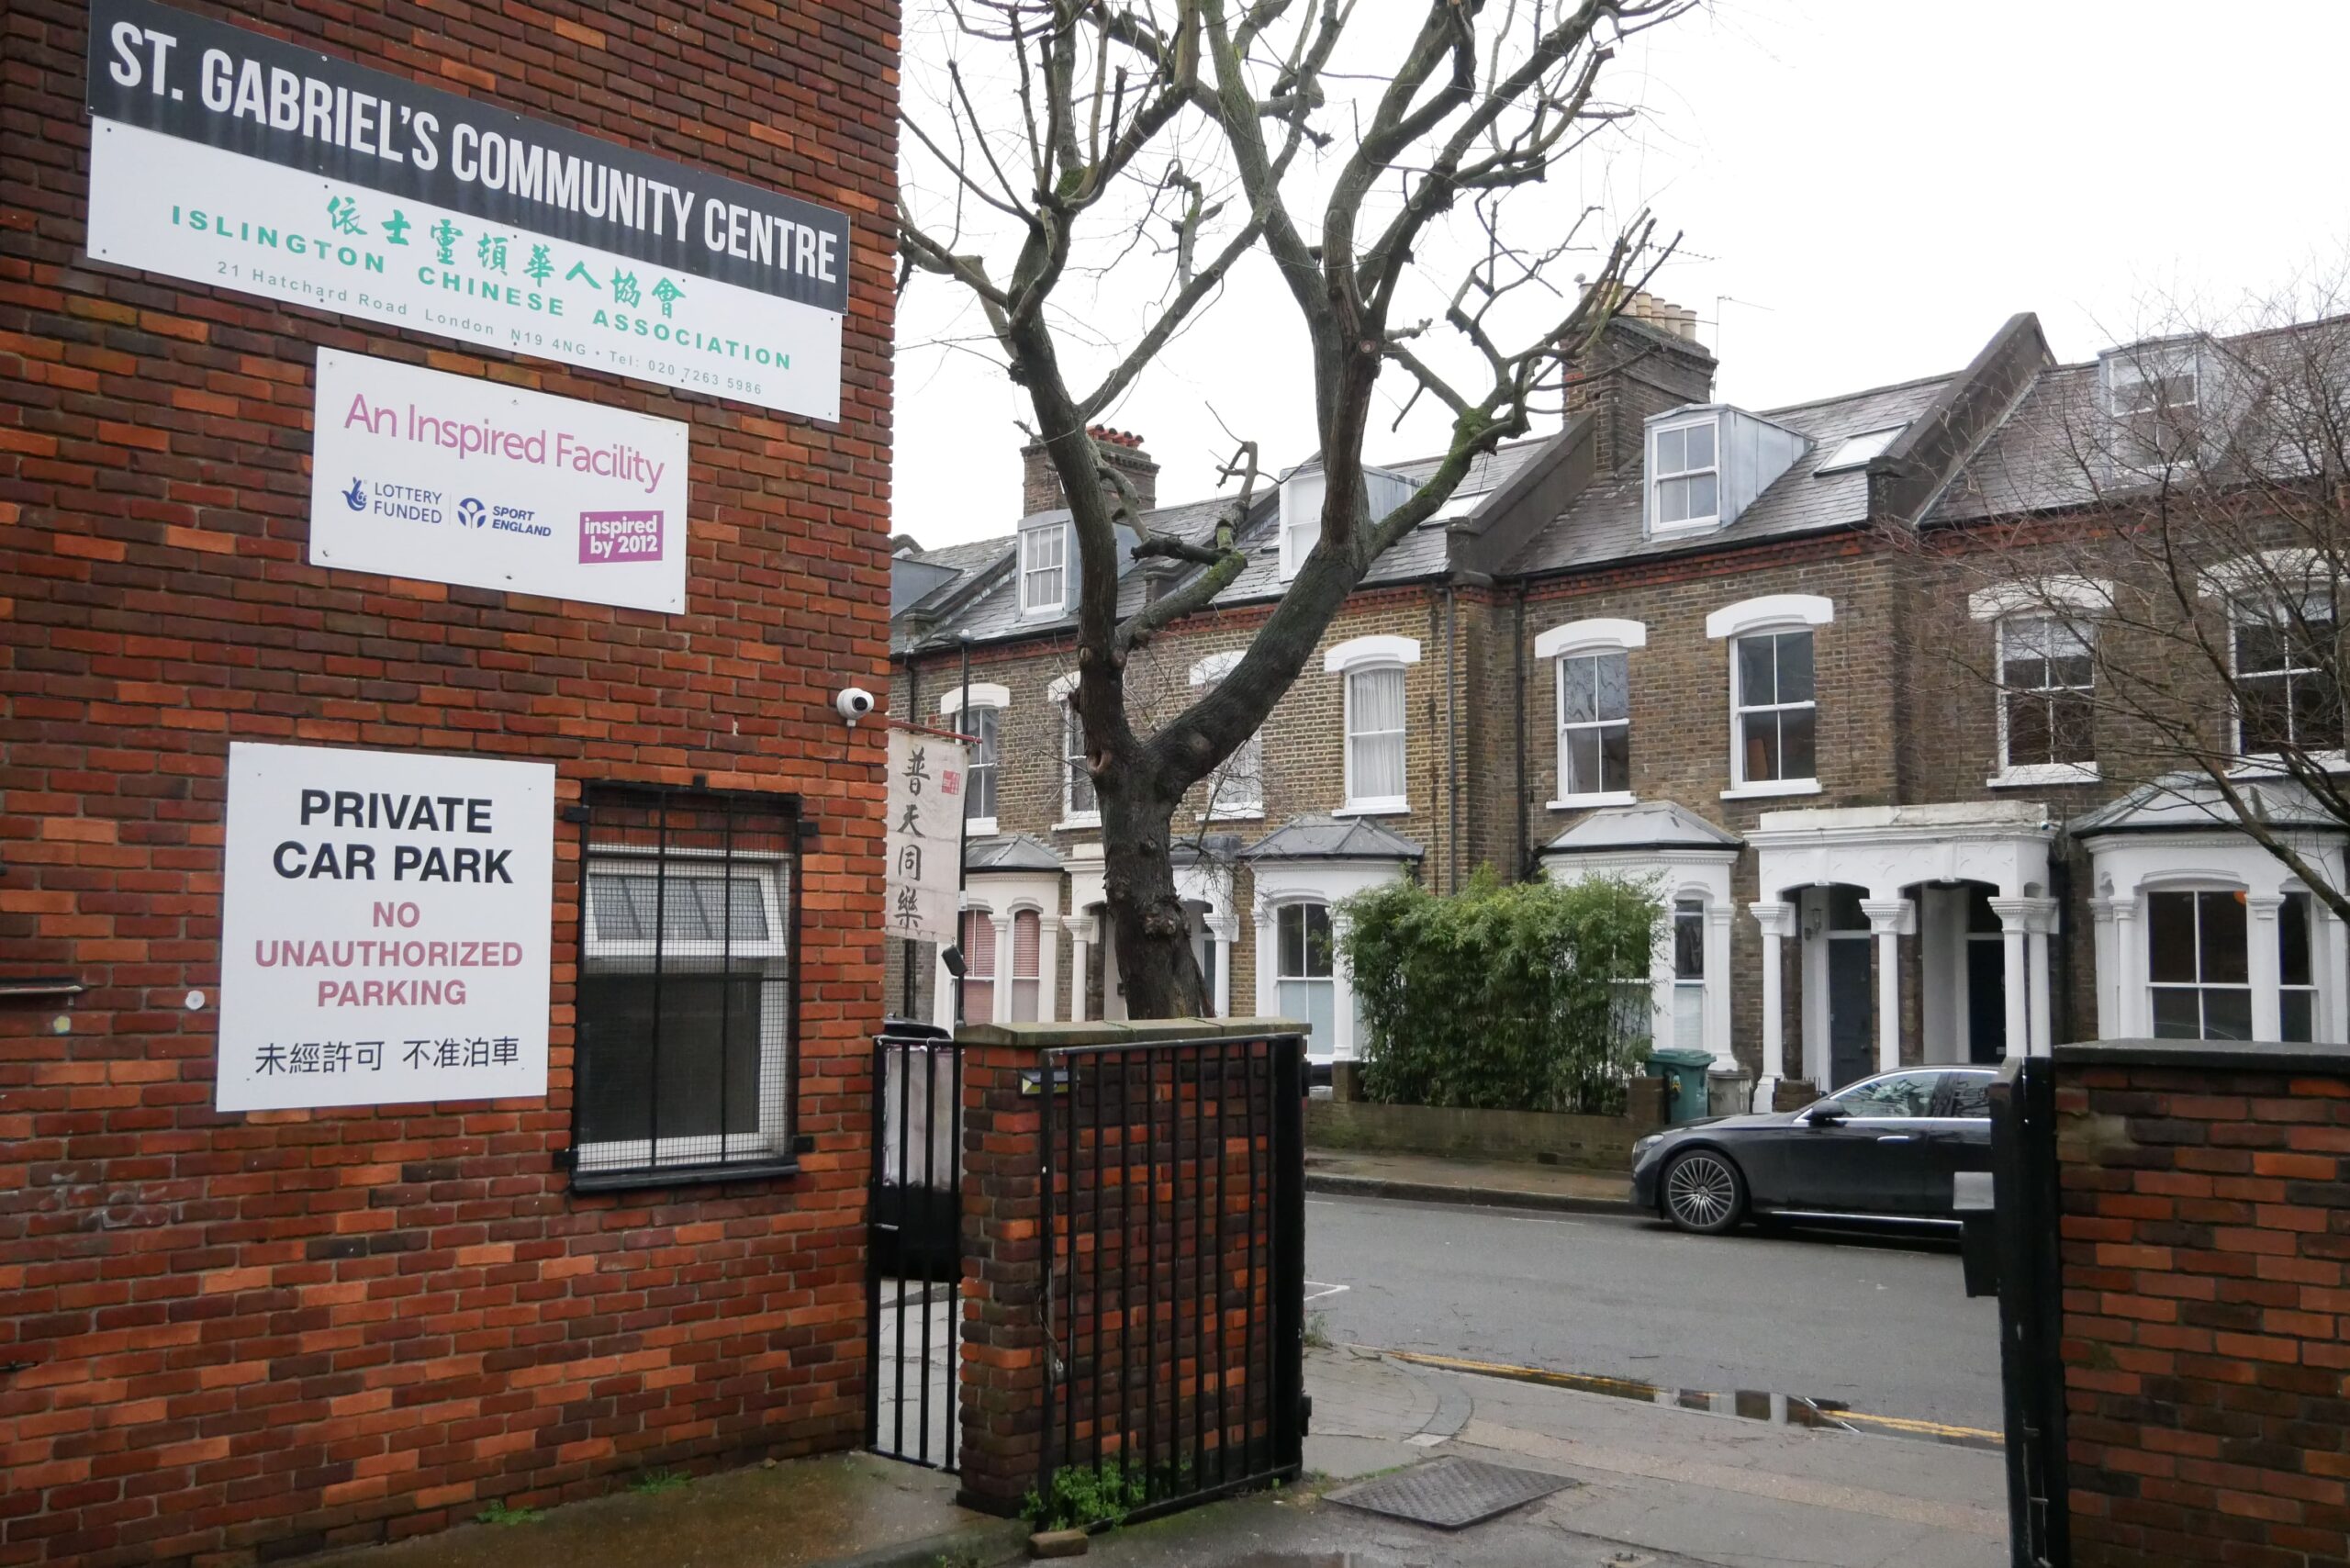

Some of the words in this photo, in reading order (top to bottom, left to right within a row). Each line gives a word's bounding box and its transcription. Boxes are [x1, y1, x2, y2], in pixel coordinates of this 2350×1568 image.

[109, 22, 183, 100] ST.
[201, 49, 439, 171] GABRIEL'S
[452, 123, 695, 241] COMMUNITY
[705, 198, 837, 284] CENTRE
[172, 205, 384, 274] ISLINGTON
[418, 266, 563, 316] CHINESE
[593, 309, 790, 369] ASSOCIATION
[218, 261, 239, 277] 21
[252, 268, 347, 301] Hatchard
[359, 293, 407, 315] Road
[425, 308, 494, 336] London
[511, 328, 542, 346] N19
[553, 339, 586, 355] 4NG
[610, 351, 639, 367] Tel:
[649, 360, 675, 375] 020
[684, 368, 719, 386] 7263
[727, 378, 761, 395] 5986
[344, 394, 397, 436] An
[408, 404, 545, 465] Inspired
[556, 433, 665, 493] Facility
[375, 483, 442, 505] LOTTERY
[375, 501, 442, 523] FUNDED
[492, 506, 535, 521] SPORT
[492, 519, 551, 537] ENGLAND
[585, 514, 657, 539] inspired
[590, 535, 613, 558] by
[618, 534, 657, 553] 2012
[300, 789, 493, 834] PRIVATE
[273, 840, 375, 881] CAR
[394, 846, 513, 884] PARK
[373, 902, 420, 927] NO
[255, 940, 523, 968] UNAUTHORIZED
[318, 980, 466, 1007] PARKING
[255, 1041, 385, 1076] 未經許可
[403, 1036, 520, 1070] 不准泊車
